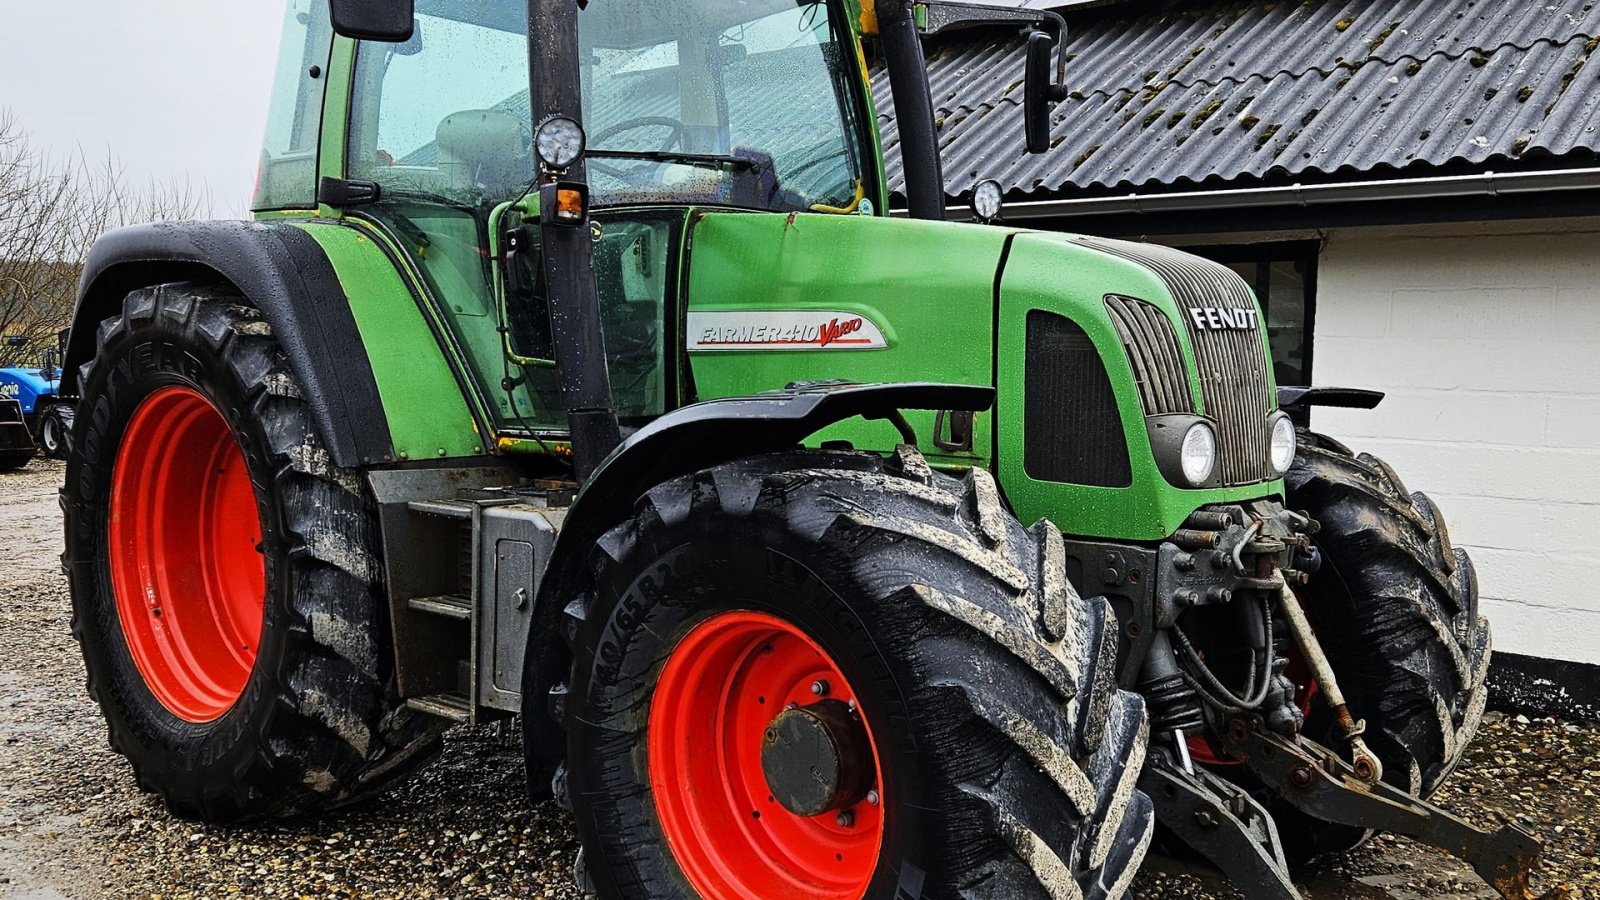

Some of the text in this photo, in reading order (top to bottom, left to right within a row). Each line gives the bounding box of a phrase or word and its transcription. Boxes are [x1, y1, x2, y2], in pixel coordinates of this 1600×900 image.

[1187, 307, 1256, 331] FENDT
[701, 325, 781, 344] FARMER
[781, 324, 819, 343] 410
